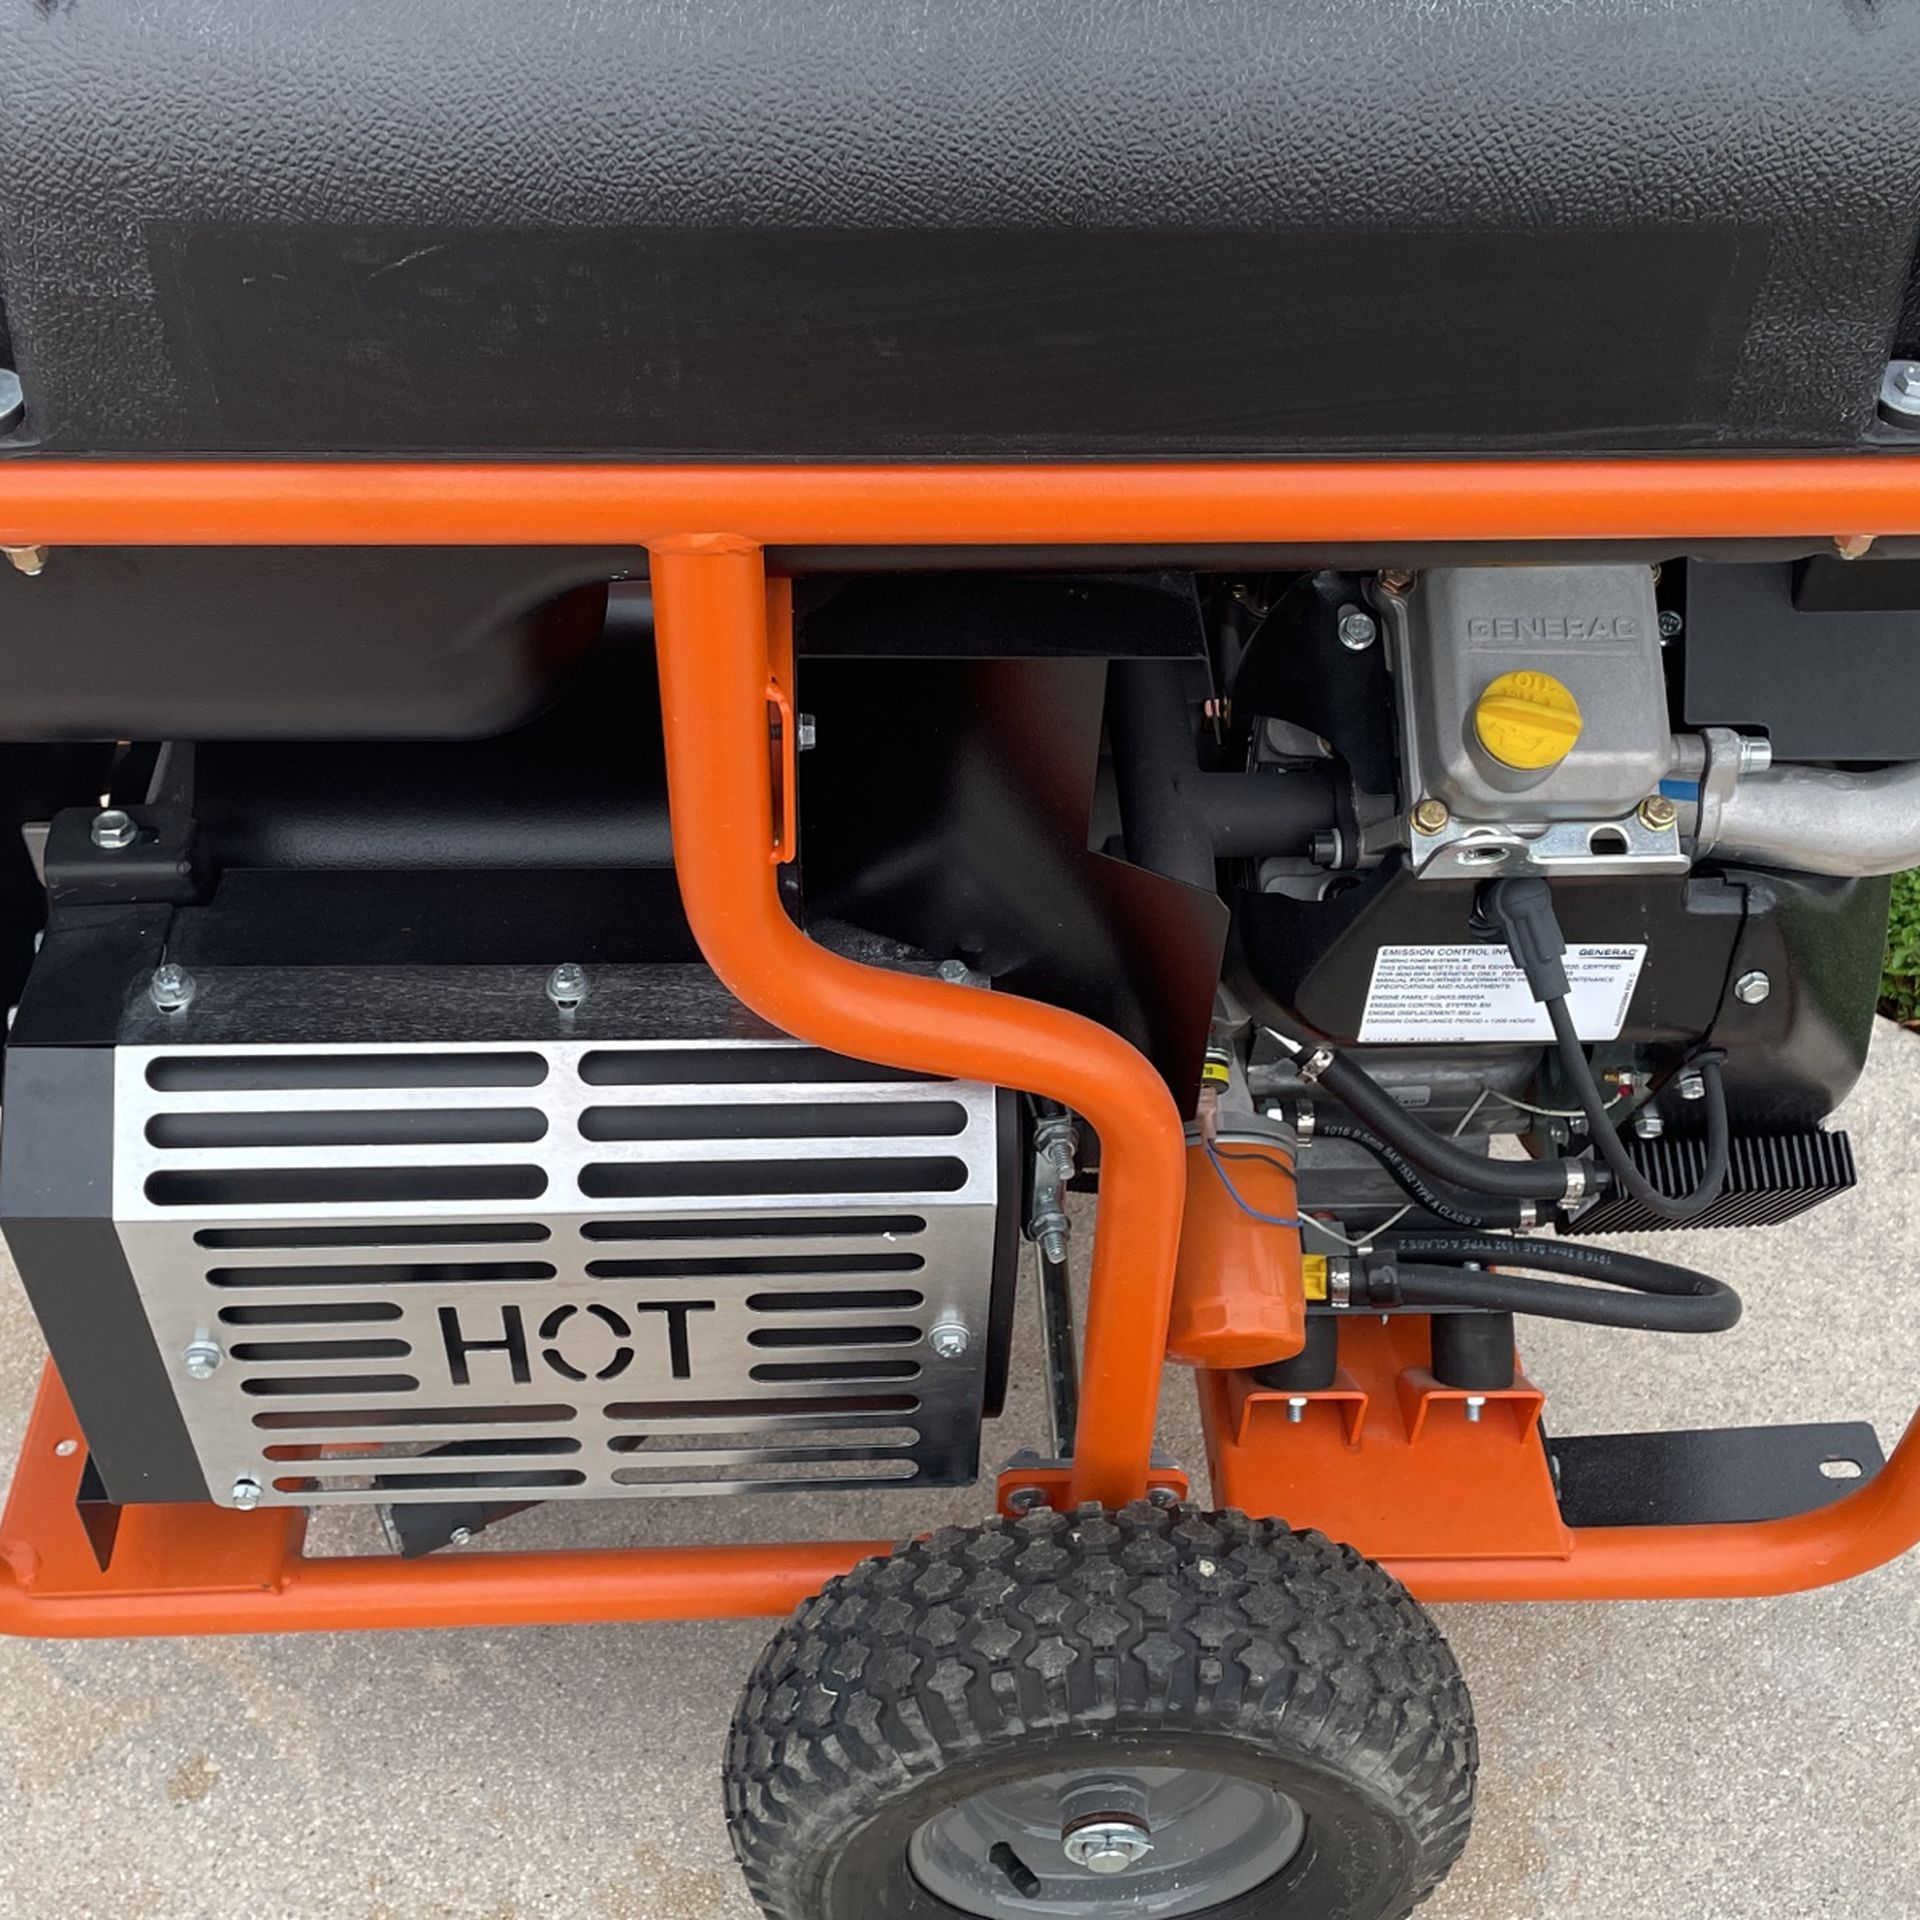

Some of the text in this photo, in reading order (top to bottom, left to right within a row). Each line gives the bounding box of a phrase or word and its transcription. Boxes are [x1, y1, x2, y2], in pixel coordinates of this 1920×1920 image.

[1468, 617, 1639, 642] GENERAC
[1513, 671, 1558, 695] OIL
[1437, 948, 1490, 956] CONTROL
[1578, 948, 1638, 956] GENERAC
[1382, 1147, 1403, 1167] SAE
[1412, 1181, 1434, 1203] TYPE
[1430, 1200, 1440, 1209] A
[1438, 1205, 1473, 1225] CLASS
[1472, 1218, 1483, 1226] 2
[1399, 1239, 1407, 1250] 2
[1408, 1239, 1449, 1250] CLASS
[1450, 1239, 1460, 1249] A
[1462, 1239, 1492, 1250] TYPE
[437, 1300, 716, 1386] HOT
